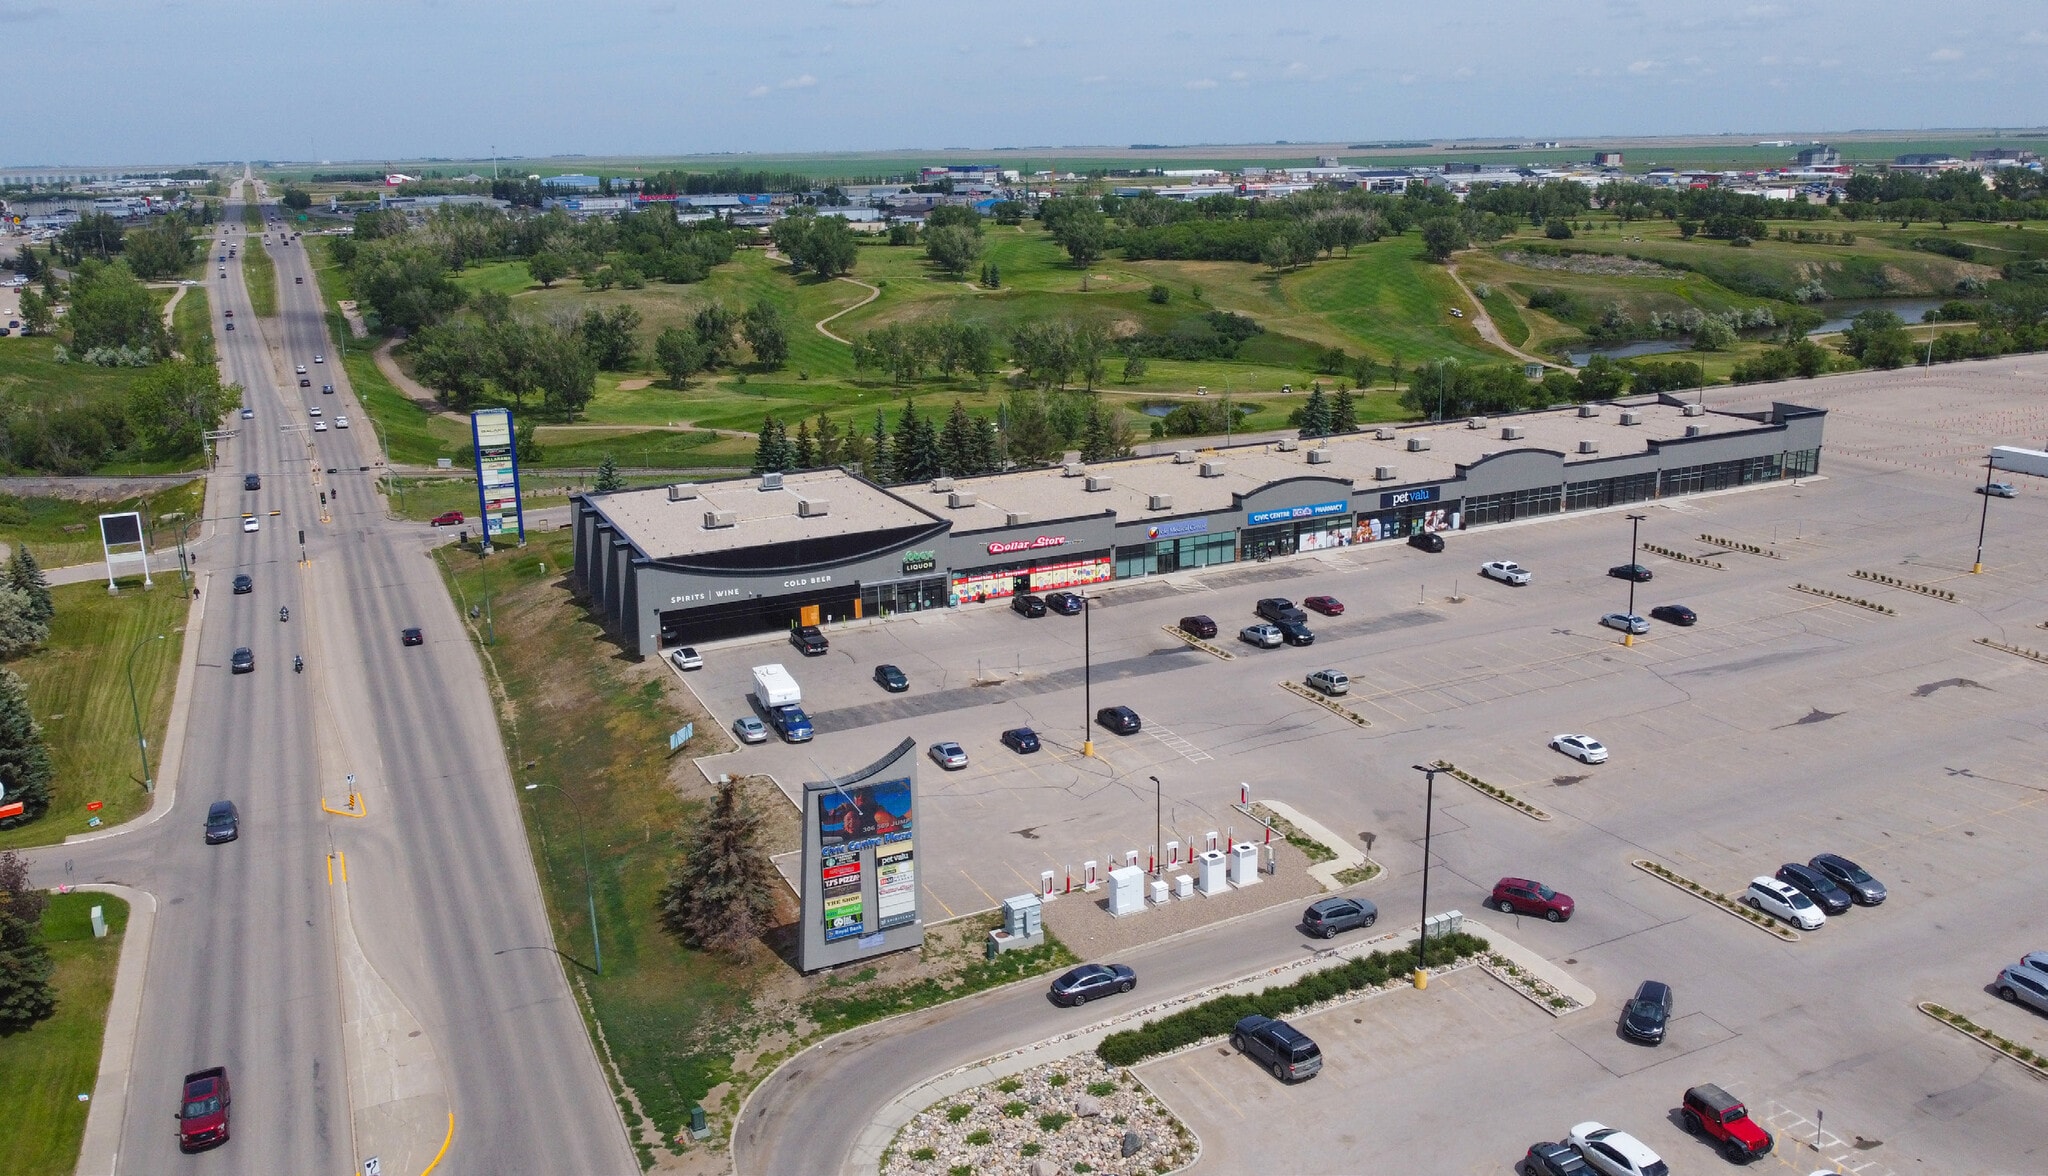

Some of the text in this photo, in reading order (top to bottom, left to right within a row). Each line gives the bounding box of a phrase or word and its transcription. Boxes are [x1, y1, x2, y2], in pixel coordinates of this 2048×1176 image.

[1392, 489, 1429, 506] pet valu
[1254, 514, 1269, 522] CIVIC
[1269, 511, 1290, 520] CENTRE
[1314, 503, 1343, 513] PHARMACY
[989, 536, 1066, 552] Dollar Store
[906, 562, 933, 571] LIQUOR
[783, 575, 832, 588] COLD BEER
[670, 588, 740, 604] SPIRITS WINE
[822, 831, 912, 856] Civic Centre Plaza
[881, 853, 909, 866] pet valu
[824, 874, 860, 887] TJ'S PIZZA
[826, 895, 860, 907] THE SHOP
[835, 927, 849, 936] Royal
